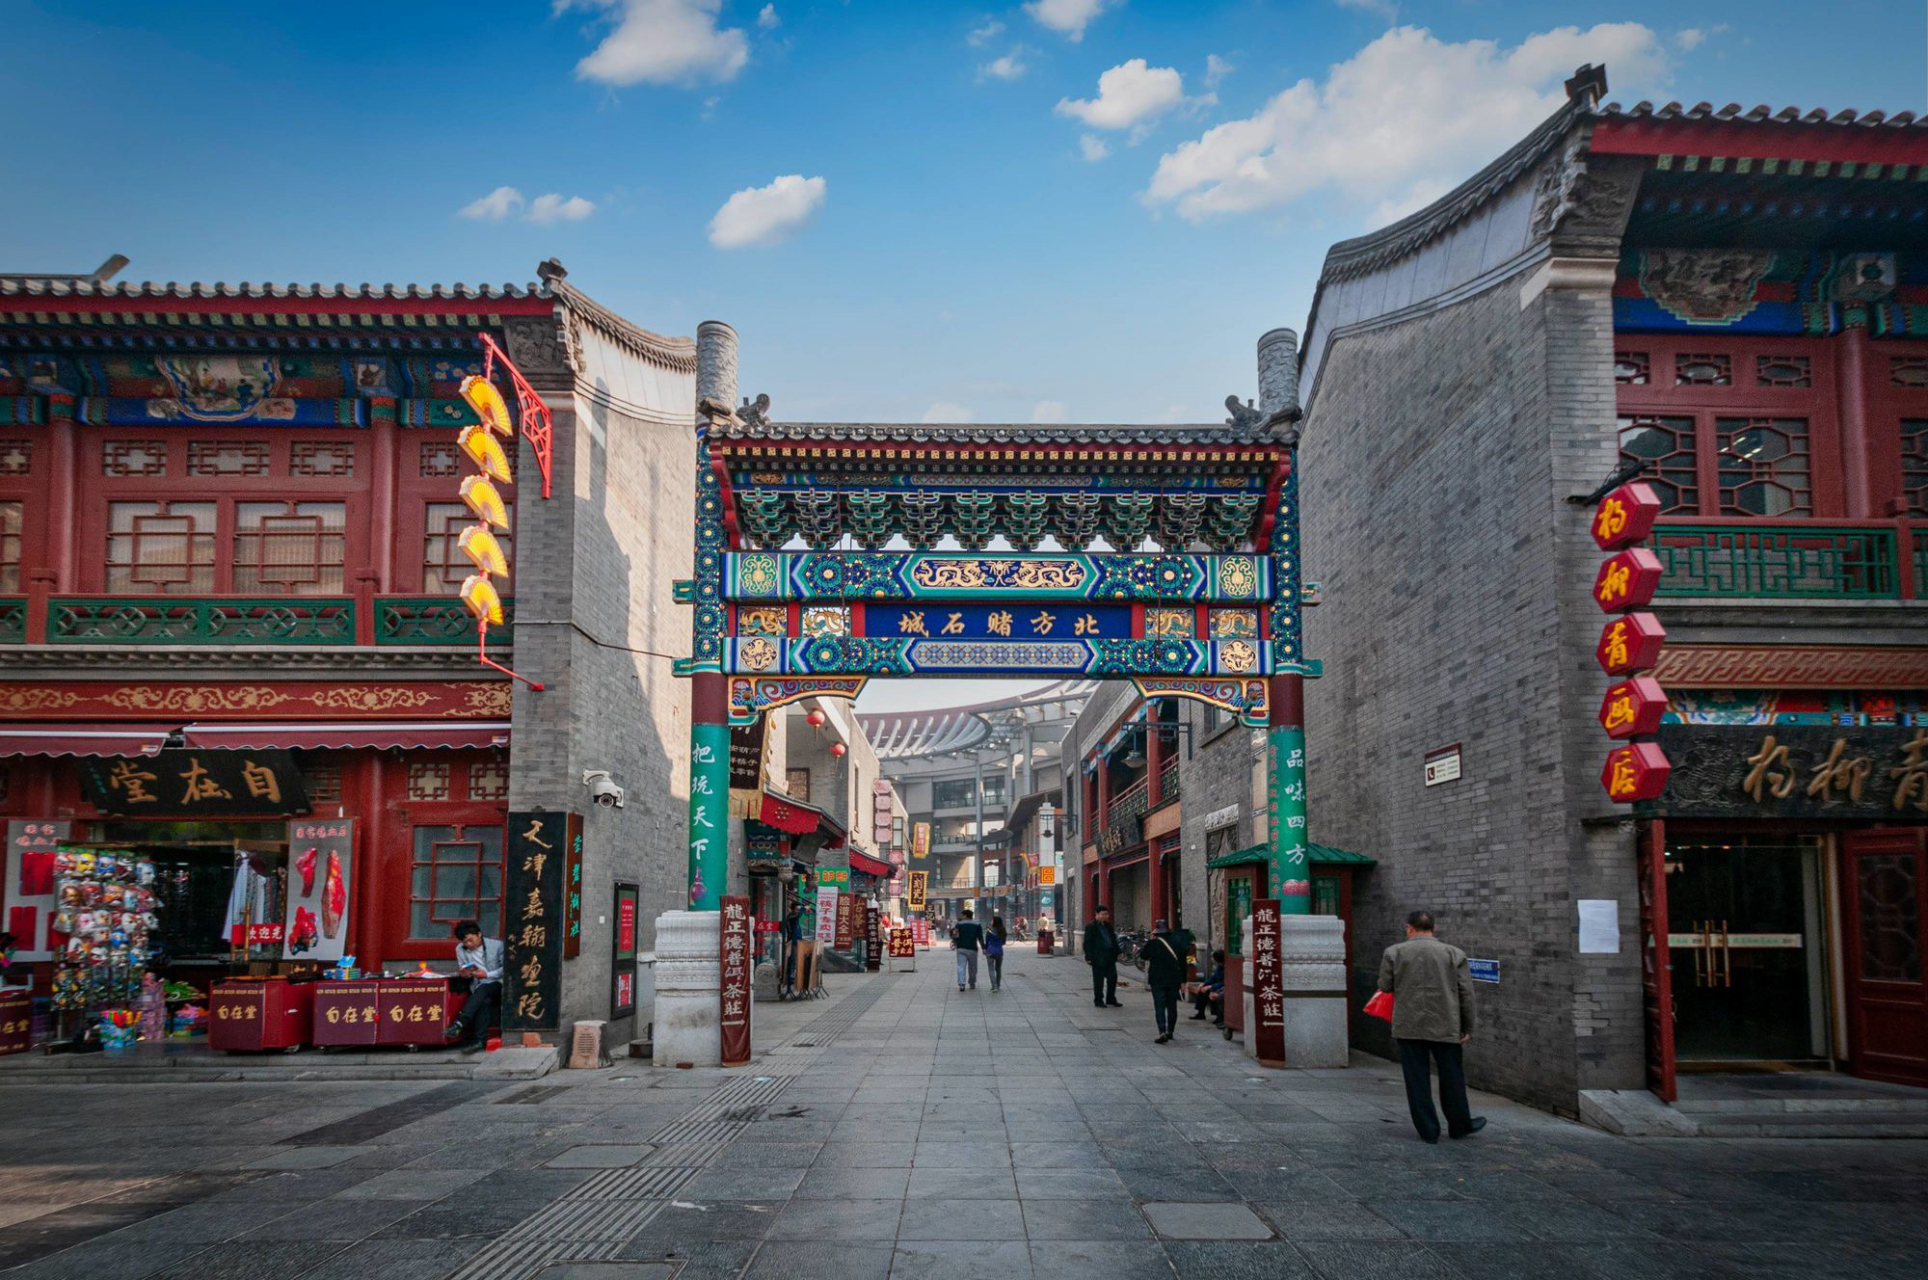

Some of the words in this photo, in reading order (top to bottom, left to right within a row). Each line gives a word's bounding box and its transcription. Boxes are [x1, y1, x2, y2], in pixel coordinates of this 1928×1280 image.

[898, 610, 1101, 638] 北方赌石城
[1598, 498, 1637, 796] 杨柳青画店
[110, 757, 281, 806] 自在堂
[690, 742, 716, 861] 把玩天下
[1284, 748, 1306, 865] 品味四方
[217, 1004, 258, 1020] 自在堂
[325, 1005, 377, 1024] 自在堂
[389, 1003, 443, 1023] 自在堂
